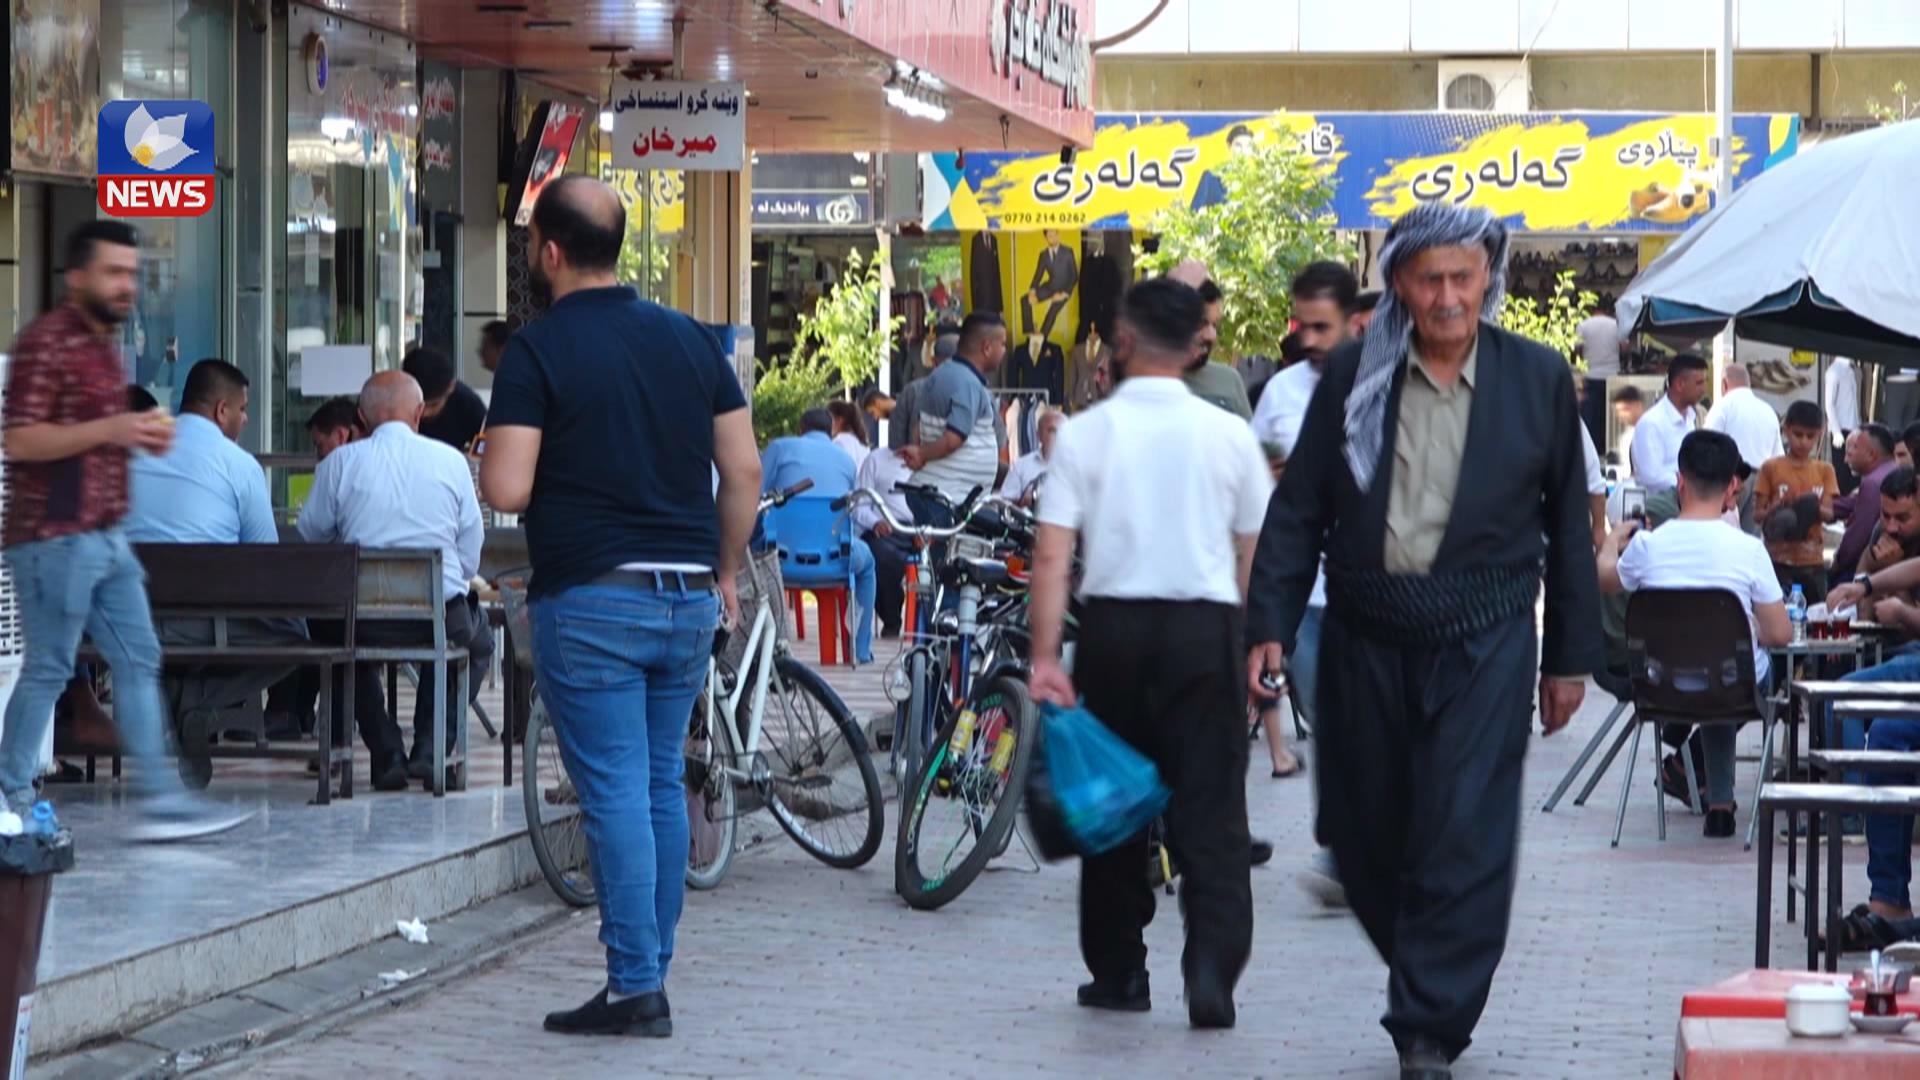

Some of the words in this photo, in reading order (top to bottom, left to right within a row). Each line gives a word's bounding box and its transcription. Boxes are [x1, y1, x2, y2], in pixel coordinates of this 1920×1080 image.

[1032, 148, 1197, 205] گەلەری
[1411, 146, 1583, 205] گەلەری
[1004, 212, 1032, 224] 0770
[1035, 212, 1056, 224] 214
[1059, 212, 1087, 224] 0262
